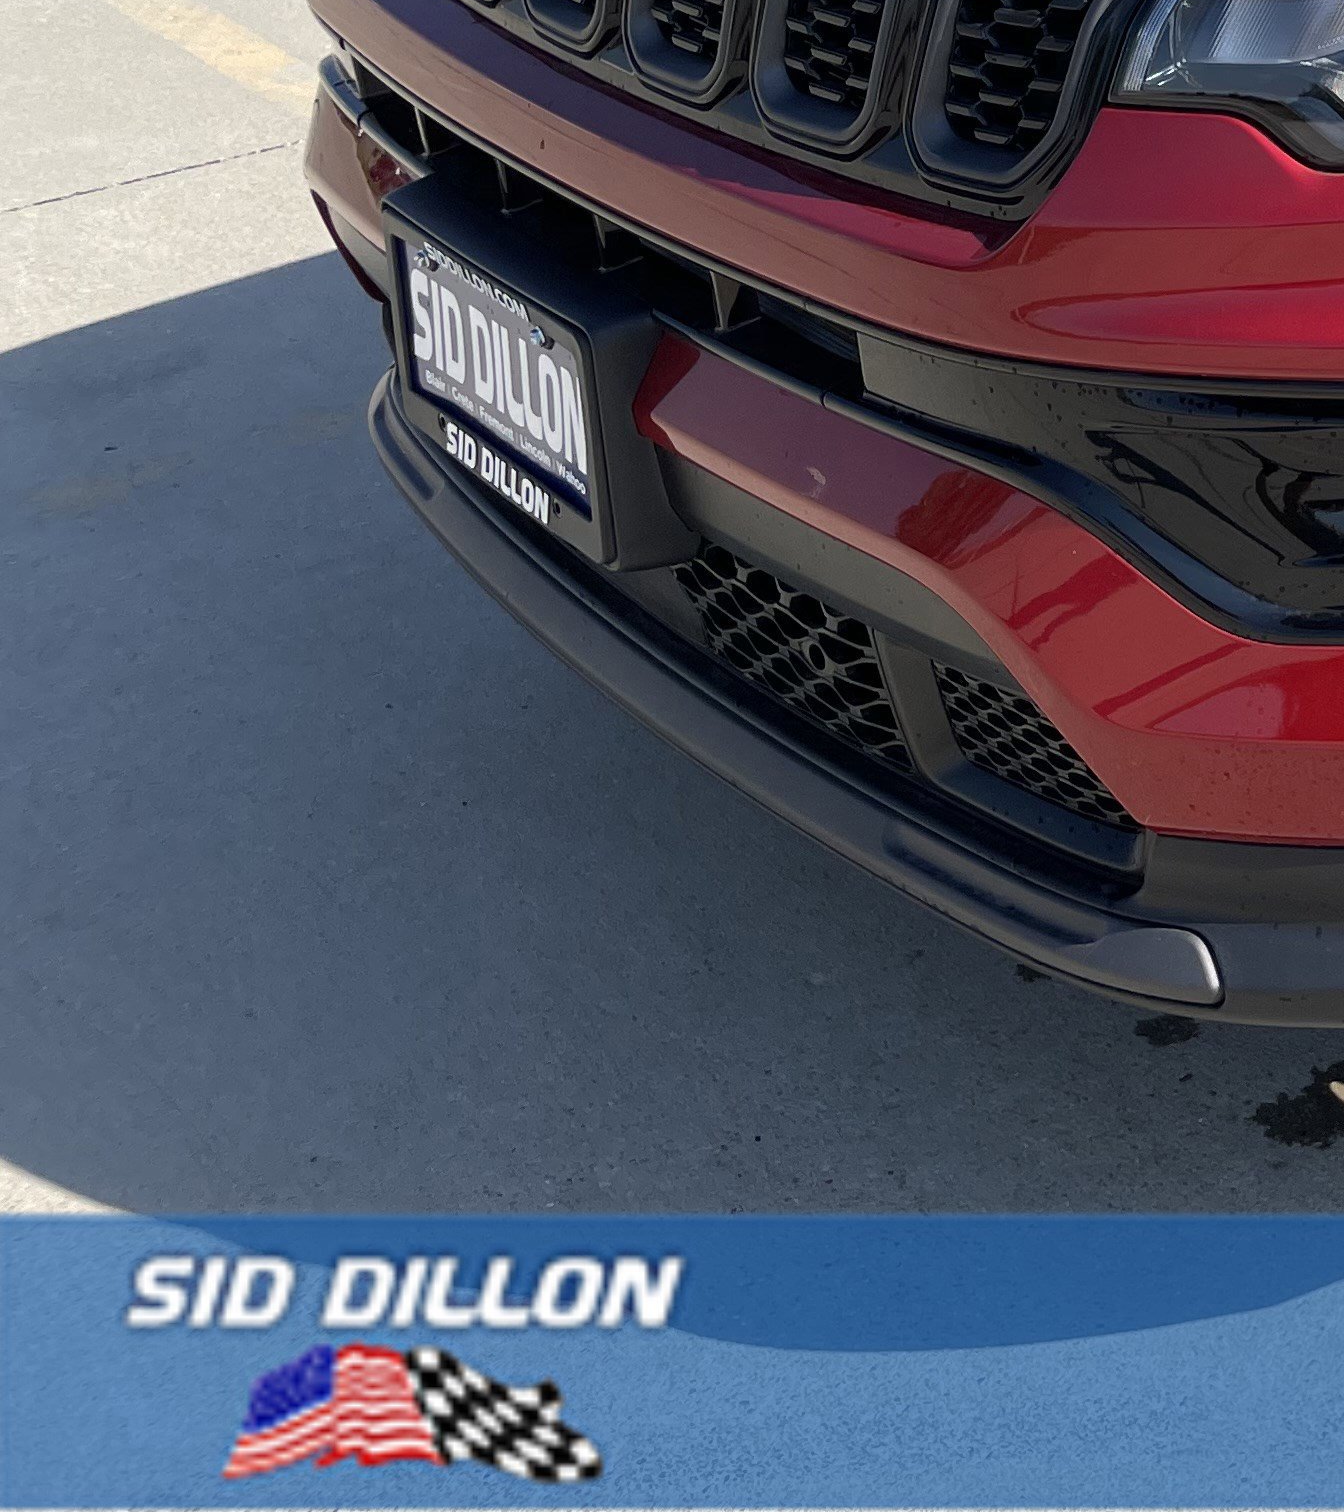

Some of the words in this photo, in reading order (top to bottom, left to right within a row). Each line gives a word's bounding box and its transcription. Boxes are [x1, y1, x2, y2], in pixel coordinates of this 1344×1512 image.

[424, 241, 529, 323] SIDDILLON.COM
[410, 268, 466, 385] SID
[468, 304, 588, 476] DILLON
[446, 421, 477, 470] SID
[481, 446, 550, 525] DILLON
[519, 434, 551, 468] Lincoln
